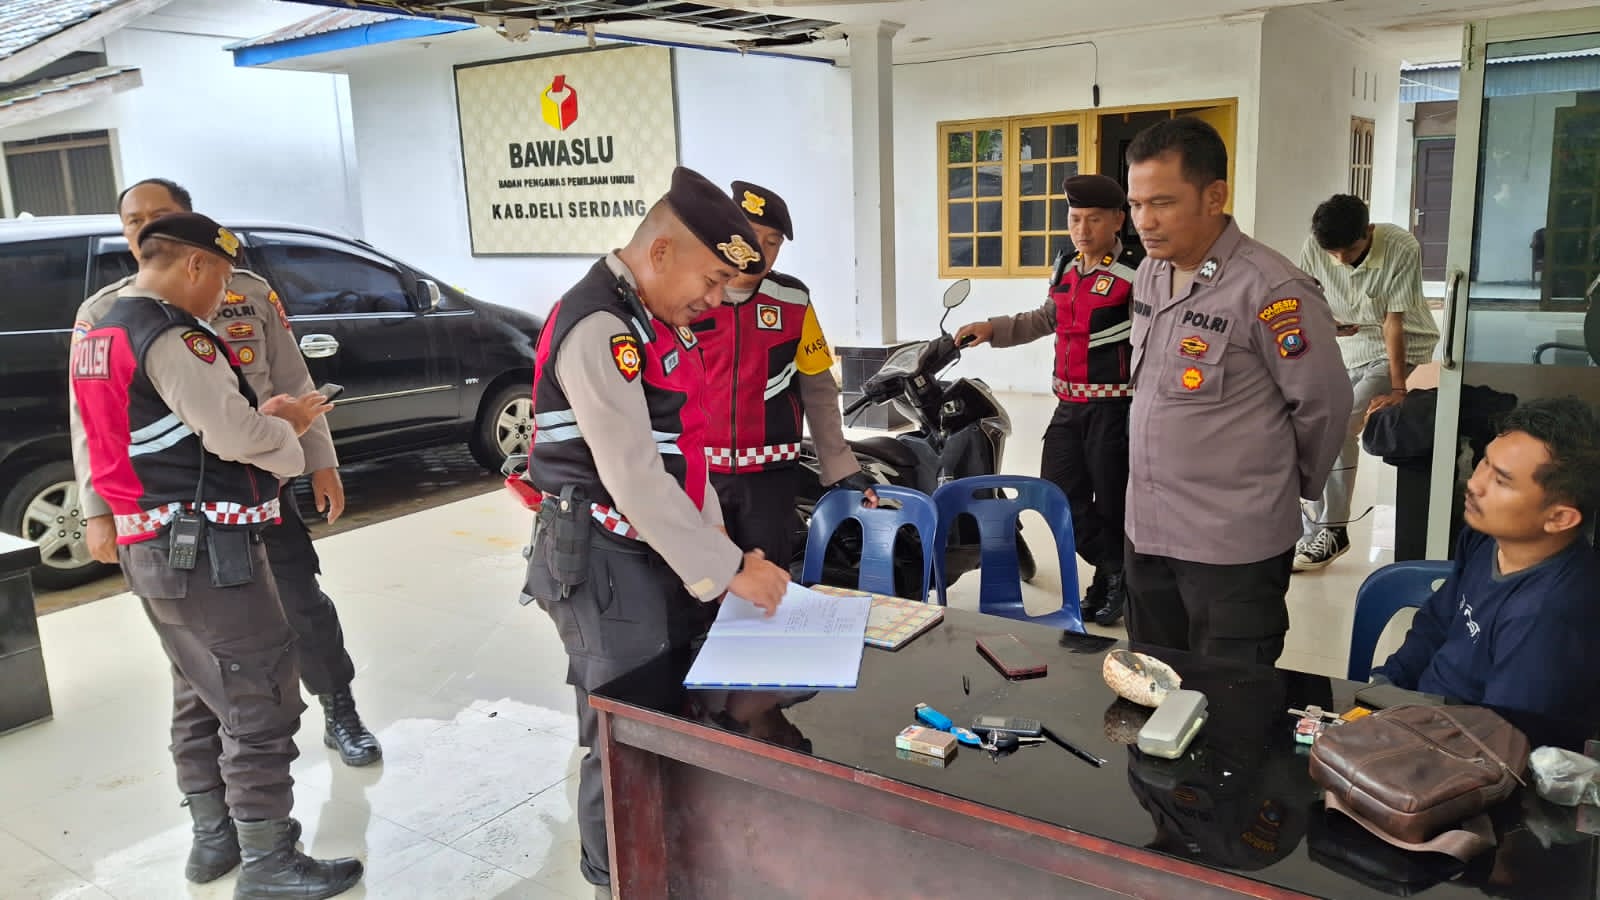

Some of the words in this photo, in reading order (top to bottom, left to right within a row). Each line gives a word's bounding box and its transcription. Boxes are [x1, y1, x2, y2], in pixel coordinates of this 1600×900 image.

[509, 136, 614, 168] BAWASLU
[498, 179, 522, 188] BADAN
[609, 175, 635, 185] UMUM
[568, 200, 647, 218] SERDANG
[217, 305, 256, 318] OLRI
[1182, 310, 1228, 333] POLRI
